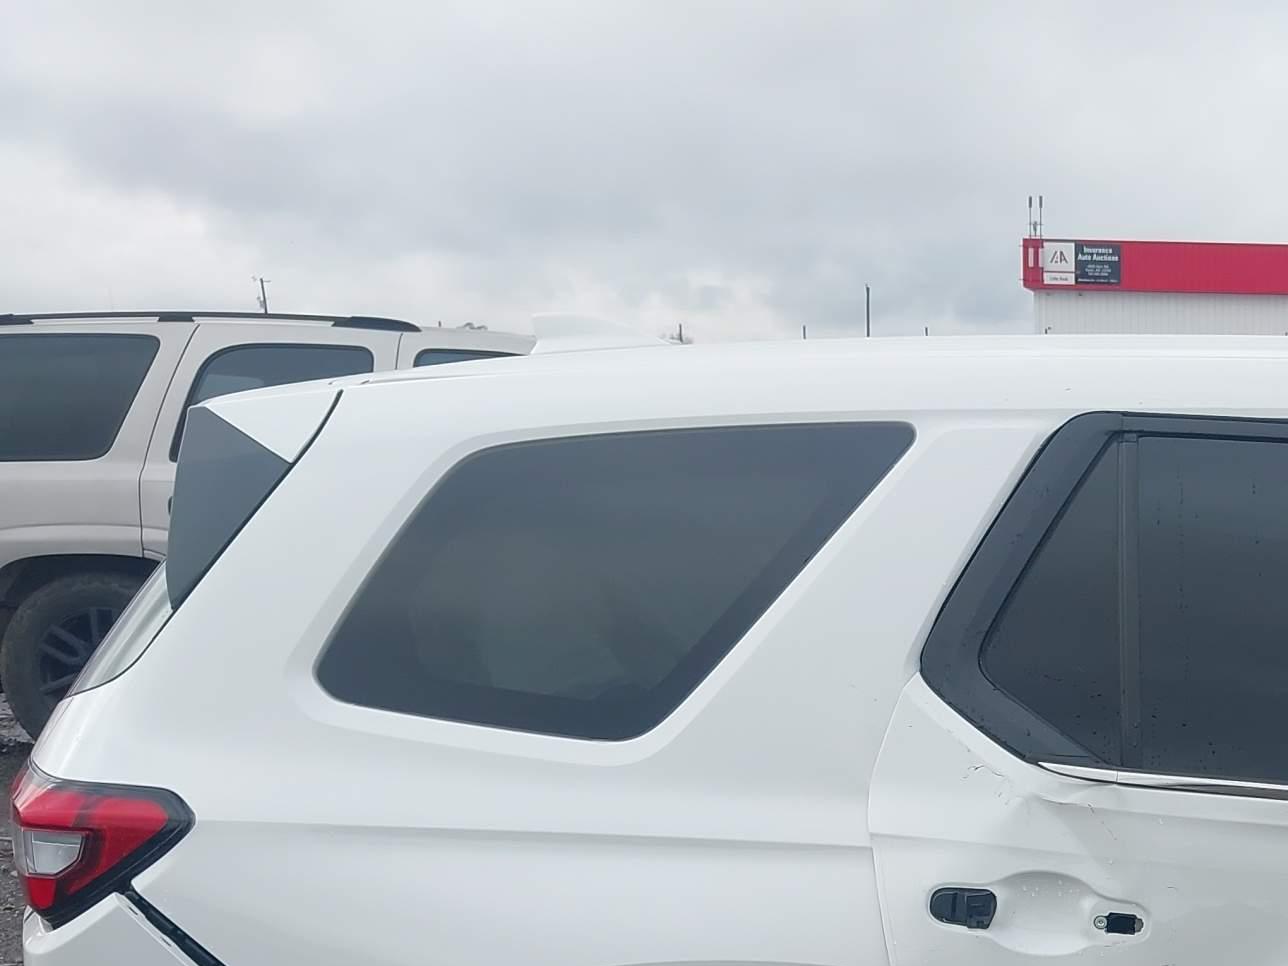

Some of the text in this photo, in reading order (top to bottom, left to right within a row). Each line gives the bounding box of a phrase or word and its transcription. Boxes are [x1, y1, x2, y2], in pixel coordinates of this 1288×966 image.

[1083, 246, 1113, 254] Insurance
[1077, 253, 1119, 262] Auto Auctions
